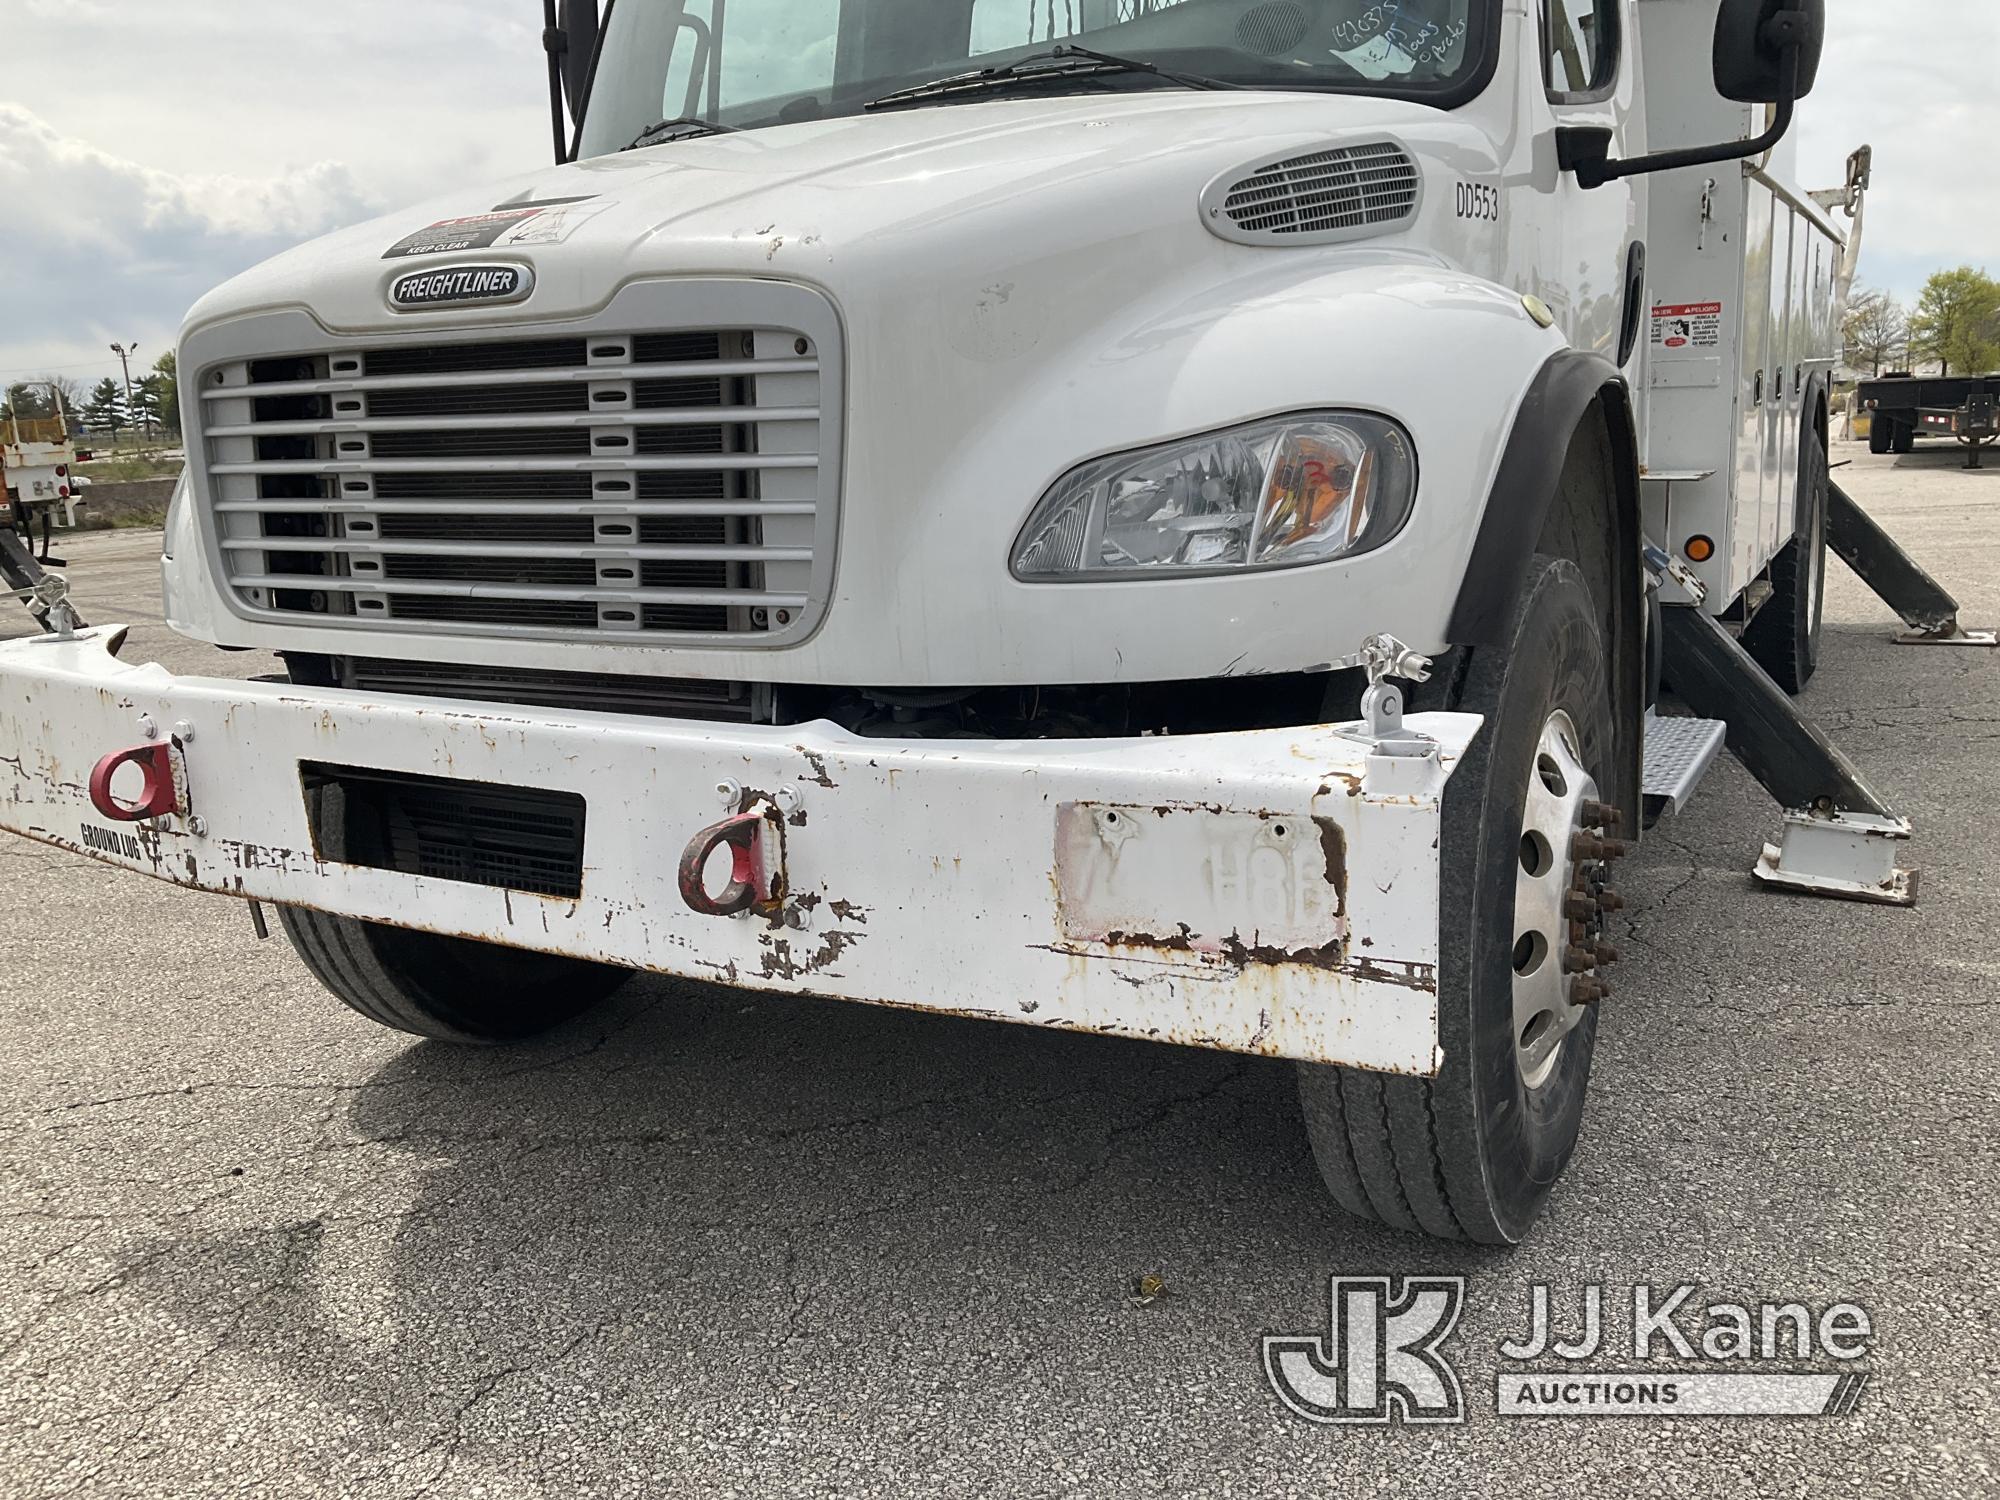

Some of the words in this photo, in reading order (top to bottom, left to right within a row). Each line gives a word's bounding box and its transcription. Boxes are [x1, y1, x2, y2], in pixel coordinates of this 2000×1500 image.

[1456, 181, 1498, 222] DD553
[406, 245, 434, 255] KEEP
[434, 241, 469, 252] CLEAR
[397, 270, 513, 300] FREIGHTLINER
[80, 822, 121, 855] GROUND
[120, 832, 142, 861] LUG
